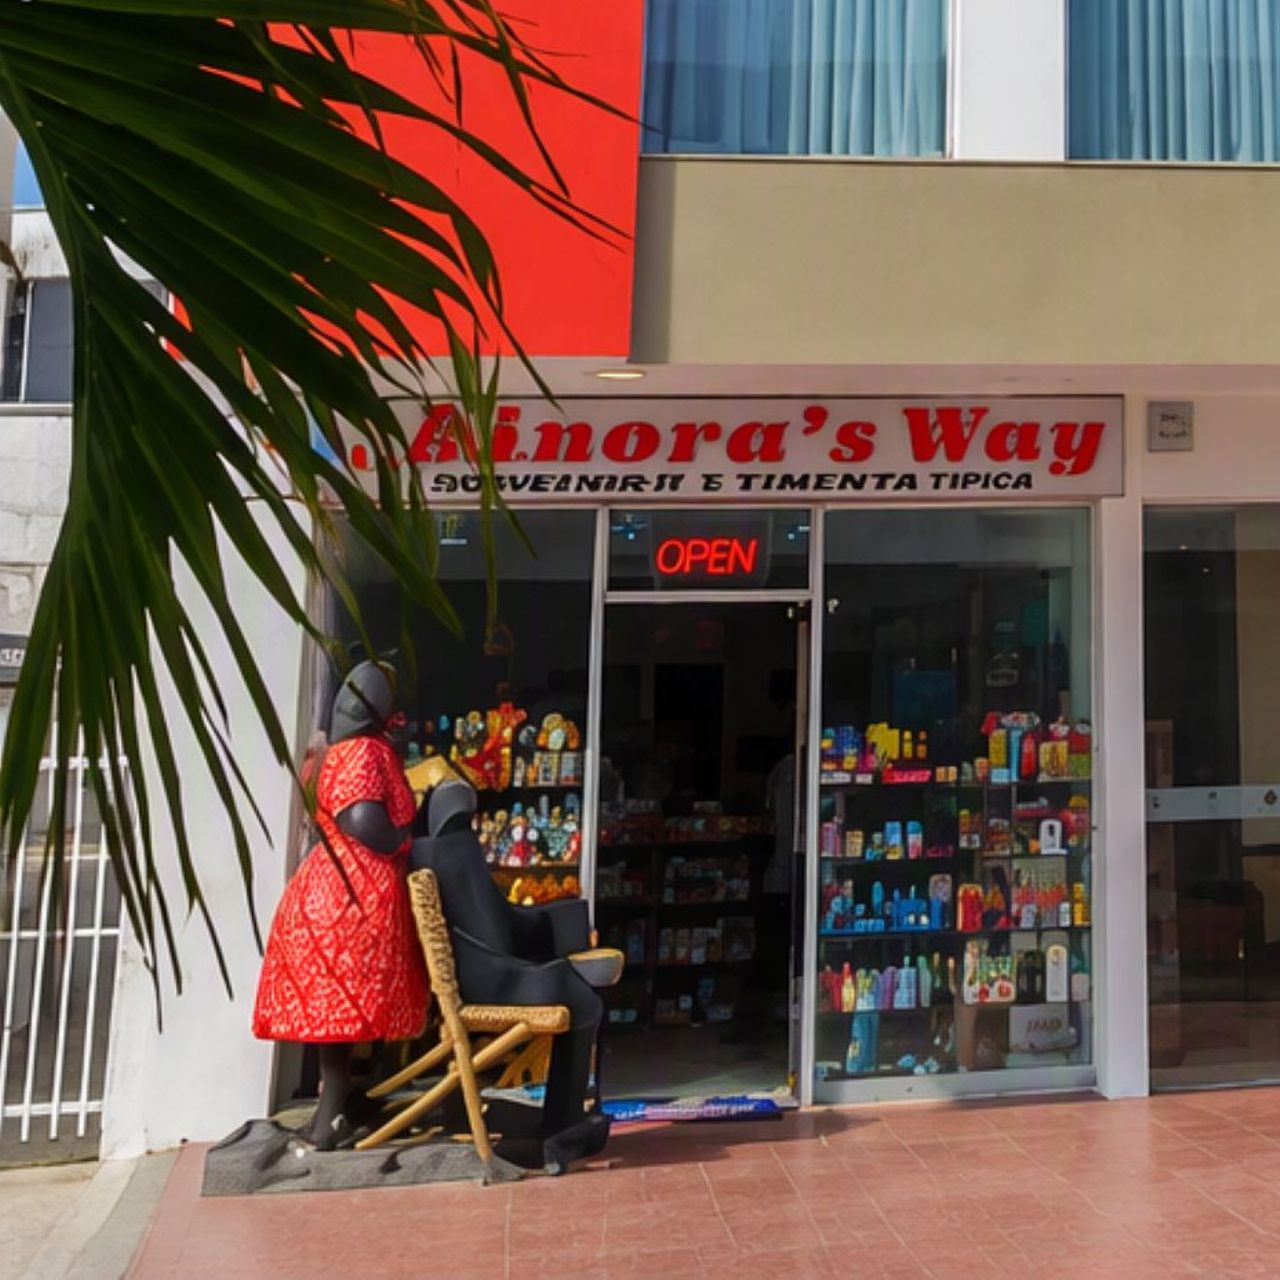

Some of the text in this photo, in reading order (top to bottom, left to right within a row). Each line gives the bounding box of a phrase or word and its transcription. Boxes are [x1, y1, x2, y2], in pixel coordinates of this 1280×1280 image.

[903, 406, 1106, 477] Way
[929, 471, 1033, 490] TIPICA
[656, 538, 758, 575] OPEN
